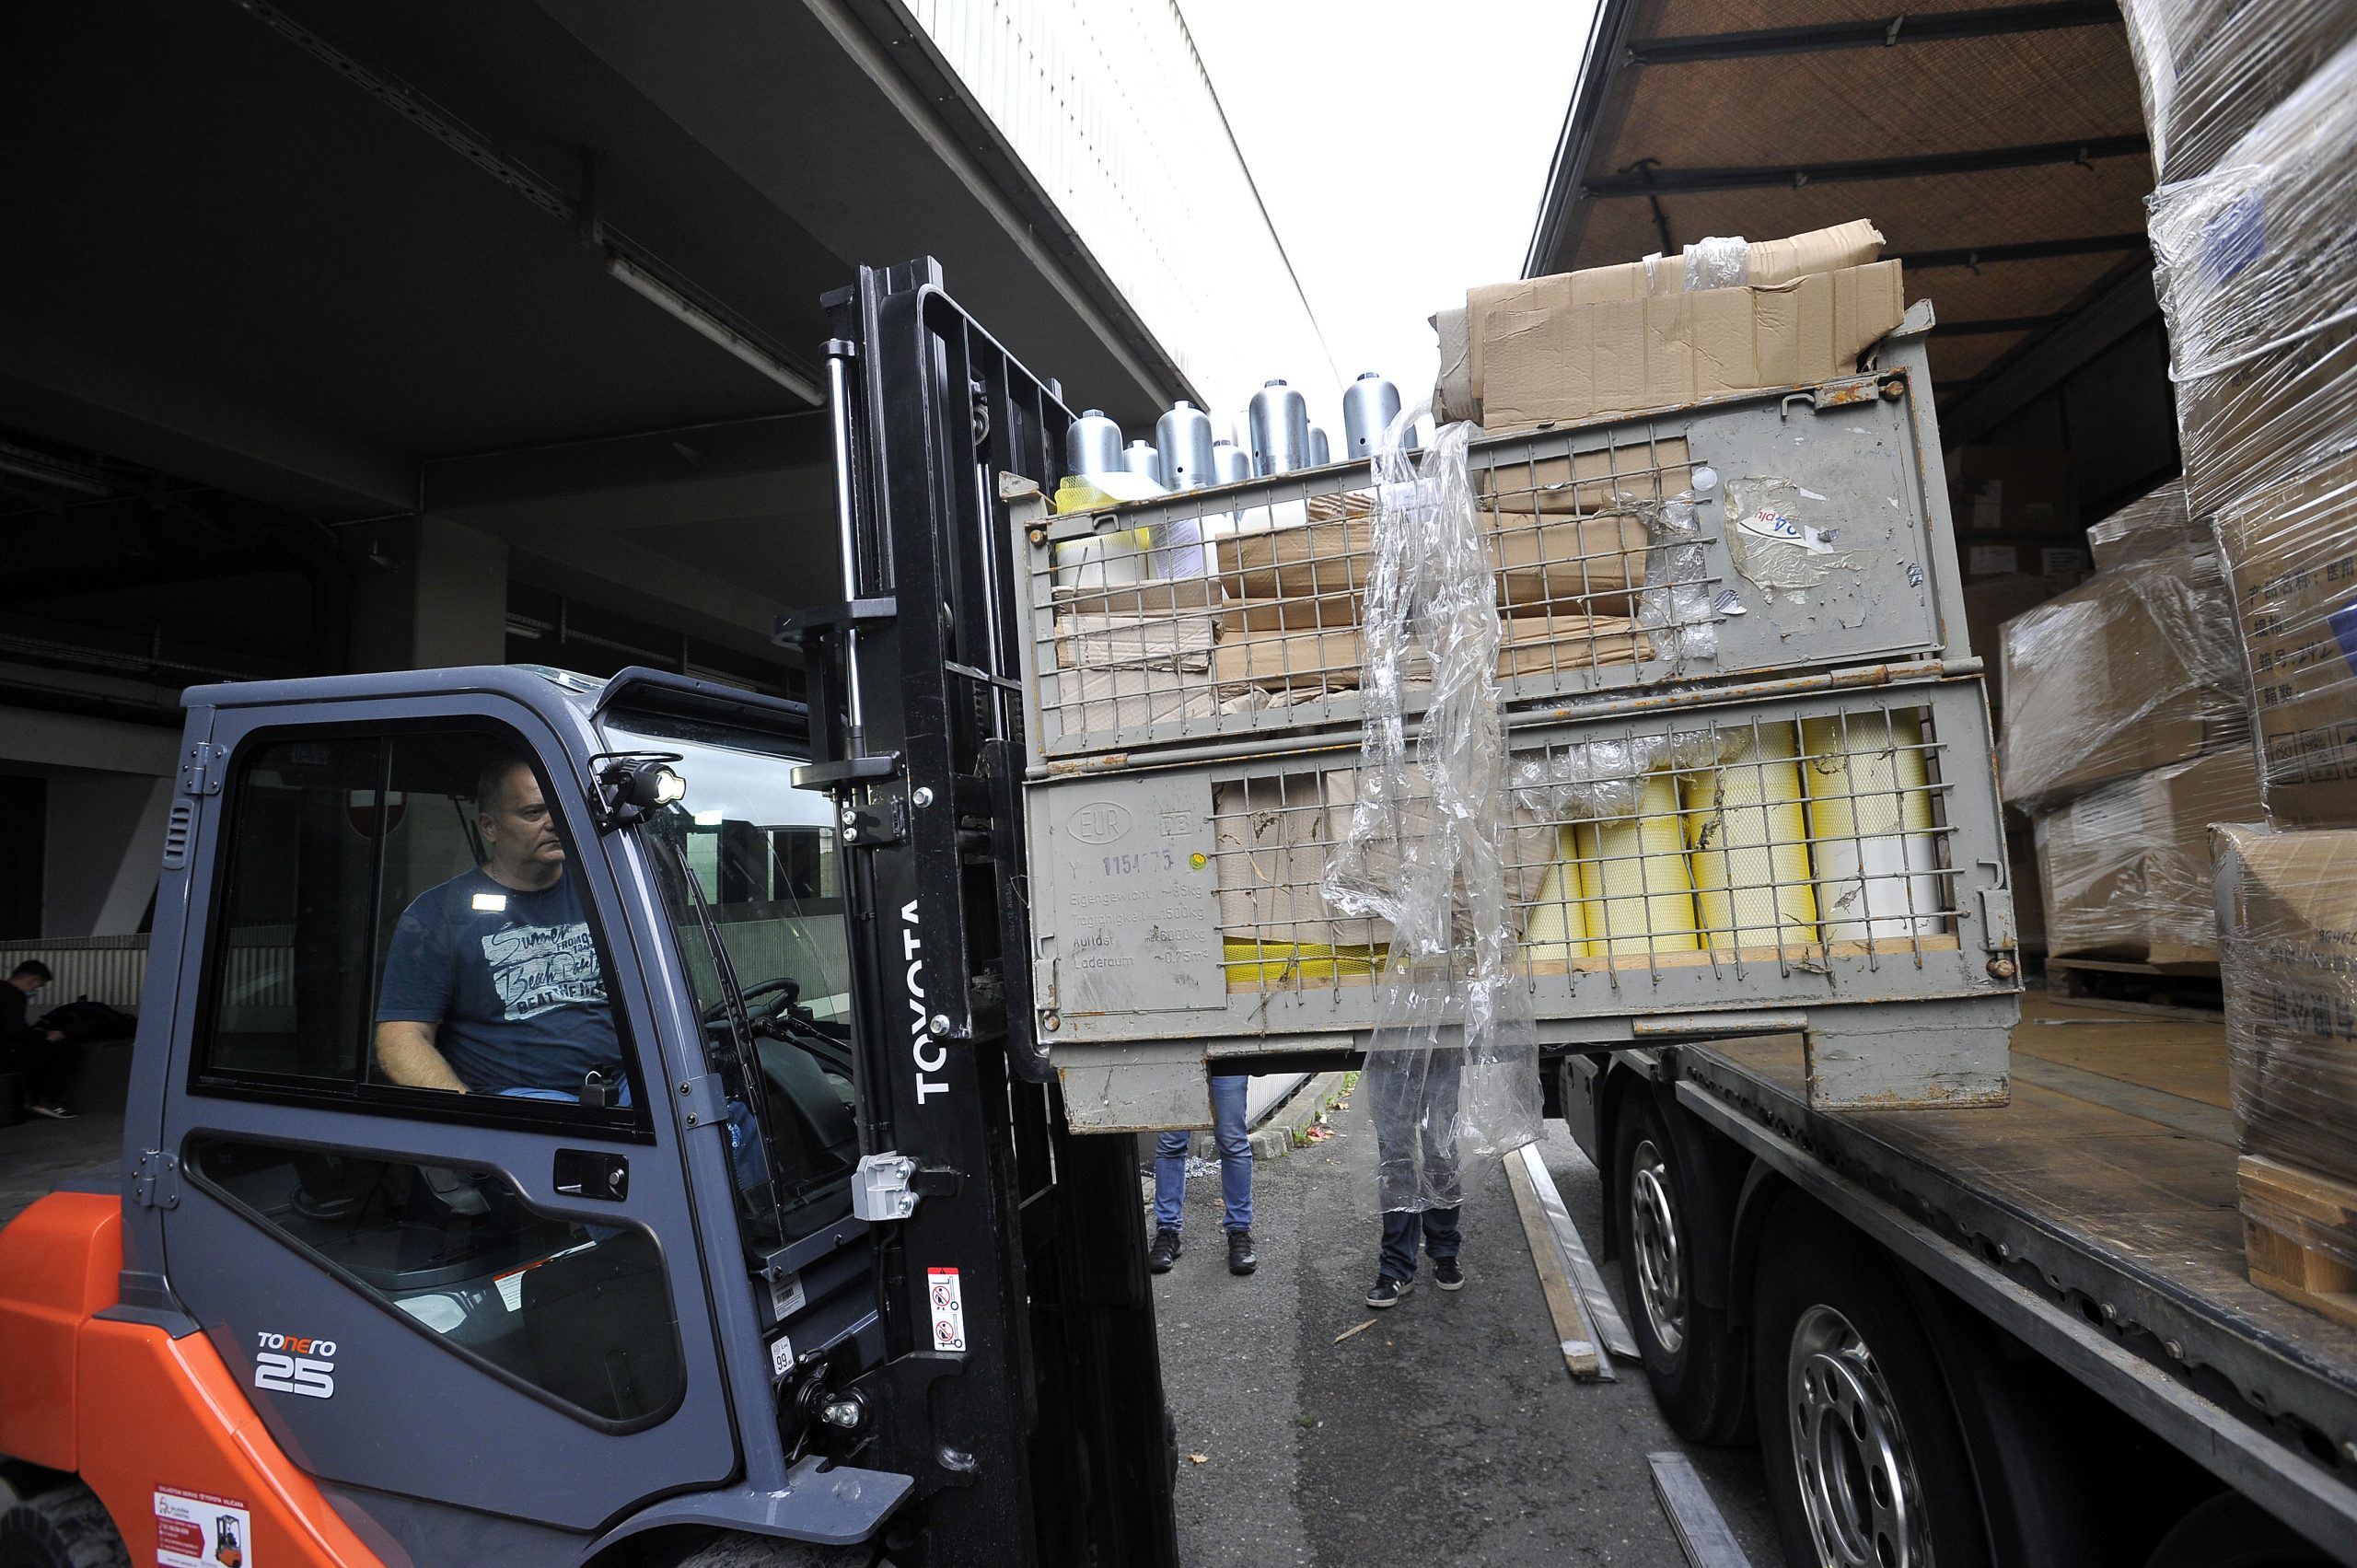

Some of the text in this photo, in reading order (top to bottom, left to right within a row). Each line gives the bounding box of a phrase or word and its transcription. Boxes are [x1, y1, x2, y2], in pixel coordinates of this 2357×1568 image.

[1080, 809, 1120, 838] EUR
[1103, 850, 1174, 876] 115475
[556, 935, 583, 951] FROM
[1074, 933, 1114, 947] Auflast
[1074, 955, 1134, 970] Laderaum
[494, 961, 556, 1008] Beach
[516, 991, 554, 1015] BEAT
[776, 1353, 788, 1371] 99
[254, 1352, 335, 1399] 25
